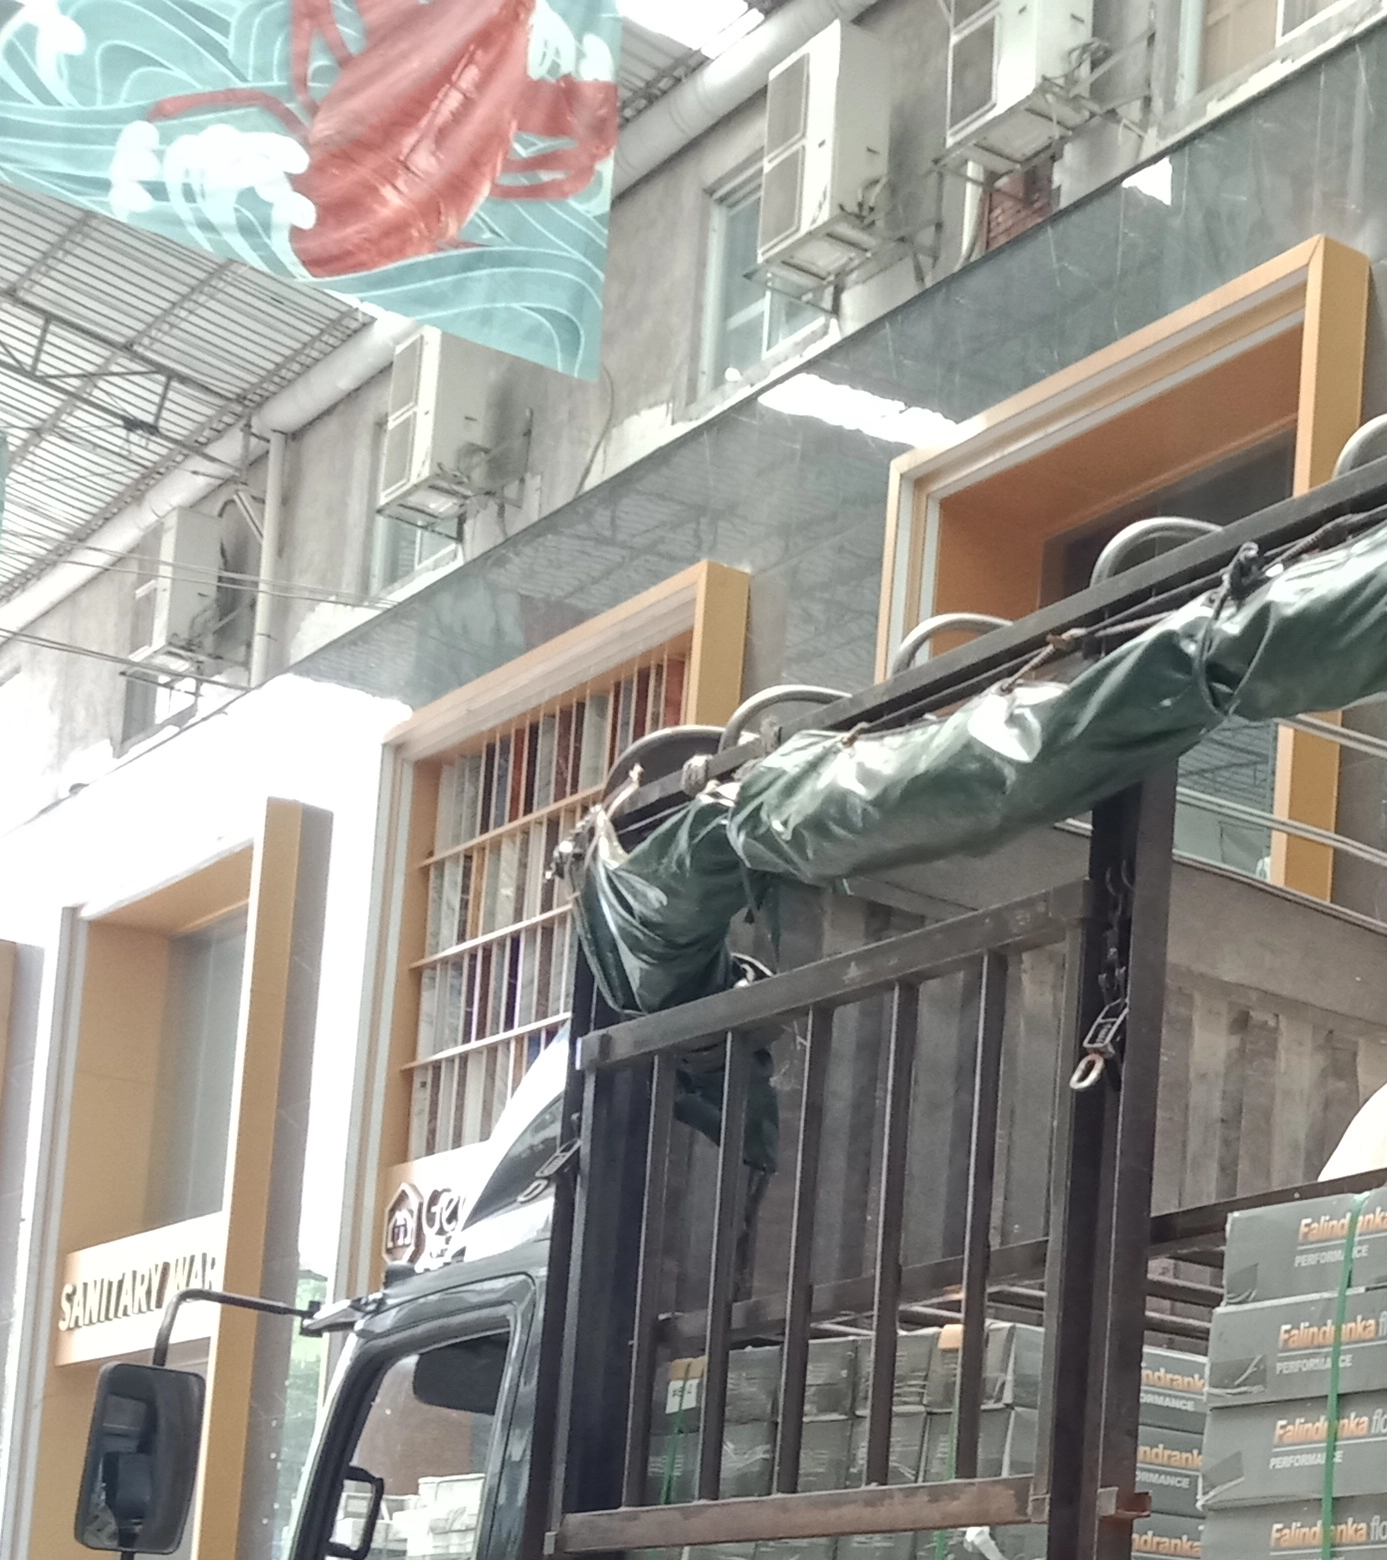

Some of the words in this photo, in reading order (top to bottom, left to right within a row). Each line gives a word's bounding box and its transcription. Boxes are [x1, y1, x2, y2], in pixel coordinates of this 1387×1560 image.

[58, 1262, 170, 1331] SANITARY
[1279, 1314, 1376, 1349] Falindnka
[1273, 1411, 1370, 1445] Falindnka
[1270, 1517, 1368, 1548] Falindnka
